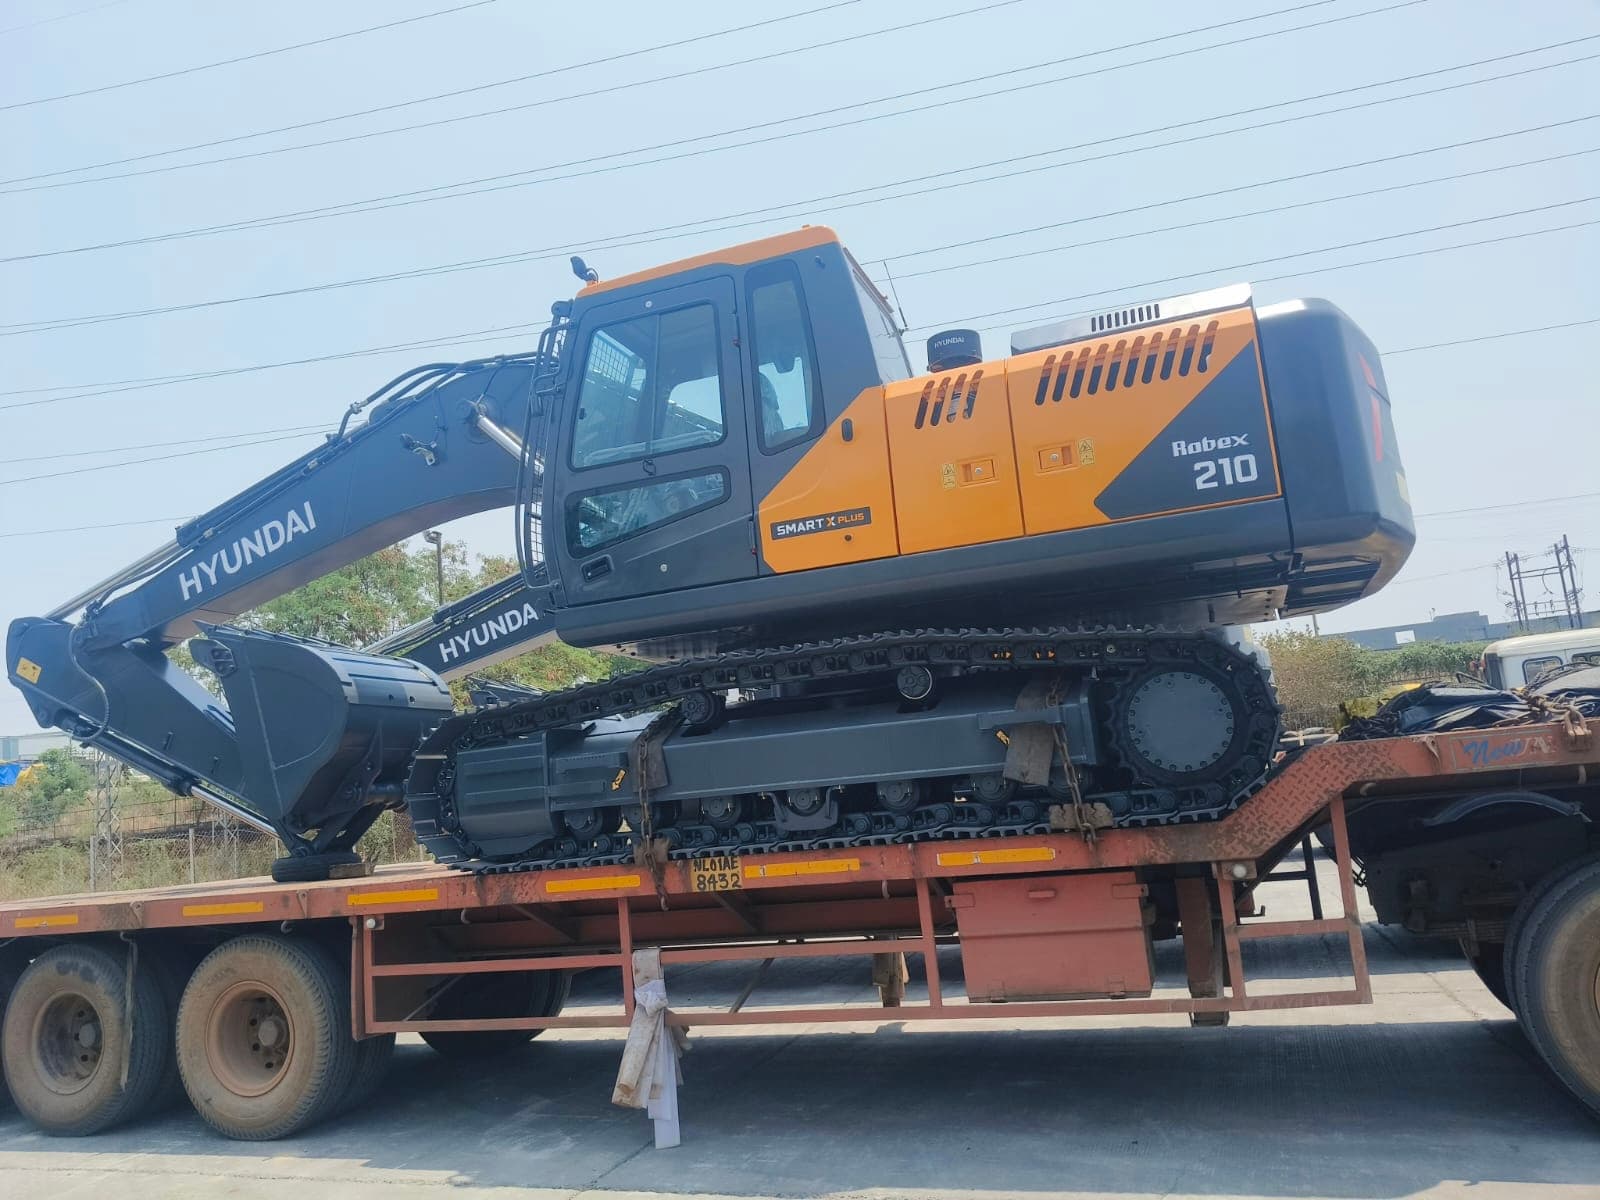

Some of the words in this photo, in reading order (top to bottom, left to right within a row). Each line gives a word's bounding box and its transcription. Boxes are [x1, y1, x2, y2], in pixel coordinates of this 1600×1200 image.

[934, 336, 965, 349] HYUNDAI
[1193, 453, 1258, 490] 210
[776, 517, 824, 536] SMART
[826, 516, 837, 527] X
[837, 512, 865, 524] PLUS
[178, 500, 316, 601] HYUNDAI
[438, 602, 540, 663] HYUNDA
[696, 872, 743, 890] 8432
